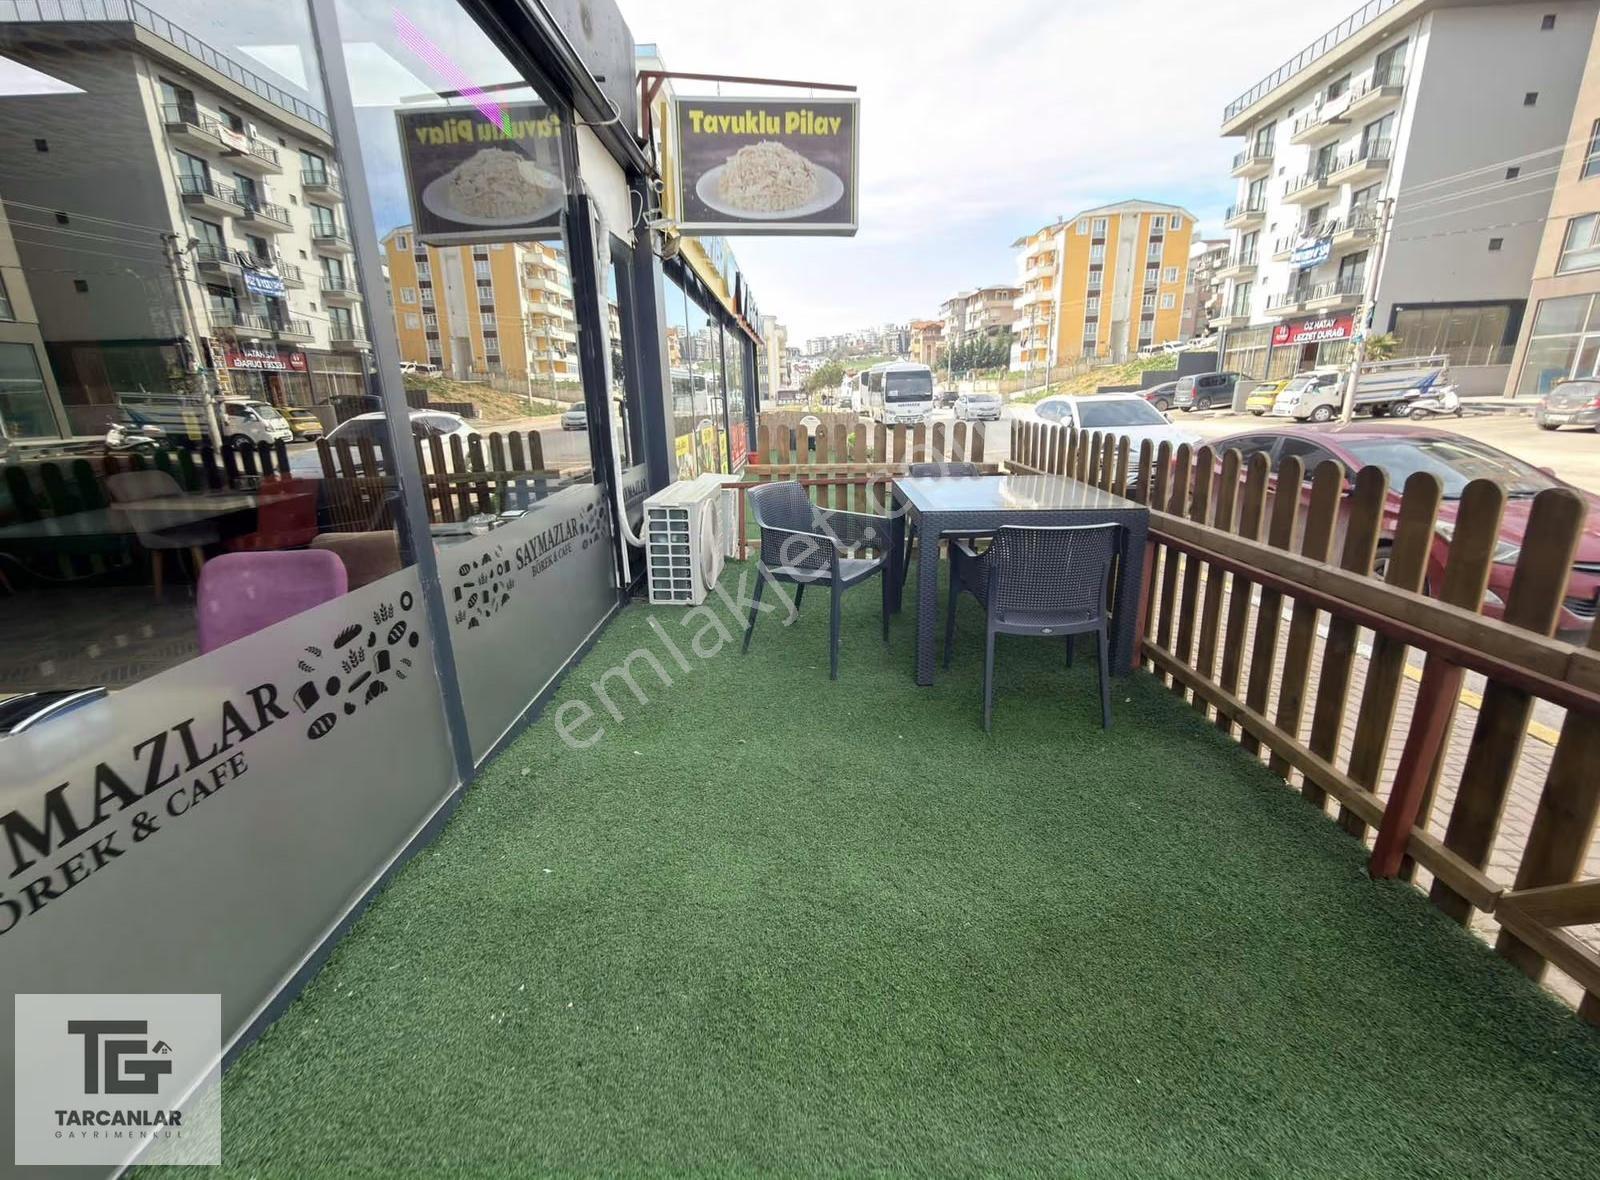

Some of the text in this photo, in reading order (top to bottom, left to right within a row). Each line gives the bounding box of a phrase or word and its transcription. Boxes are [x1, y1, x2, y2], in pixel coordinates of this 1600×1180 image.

[689, 109, 841, 135] Tavuklu Pilav
[1294, 331, 1316, 341] LEZZET
[515, 518, 579, 570] SAYMAZLAR
[0, 683, 289, 879] MAZLAR
[131, 811, 161, 843] &
[166, 751, 248, 818] CAFE
